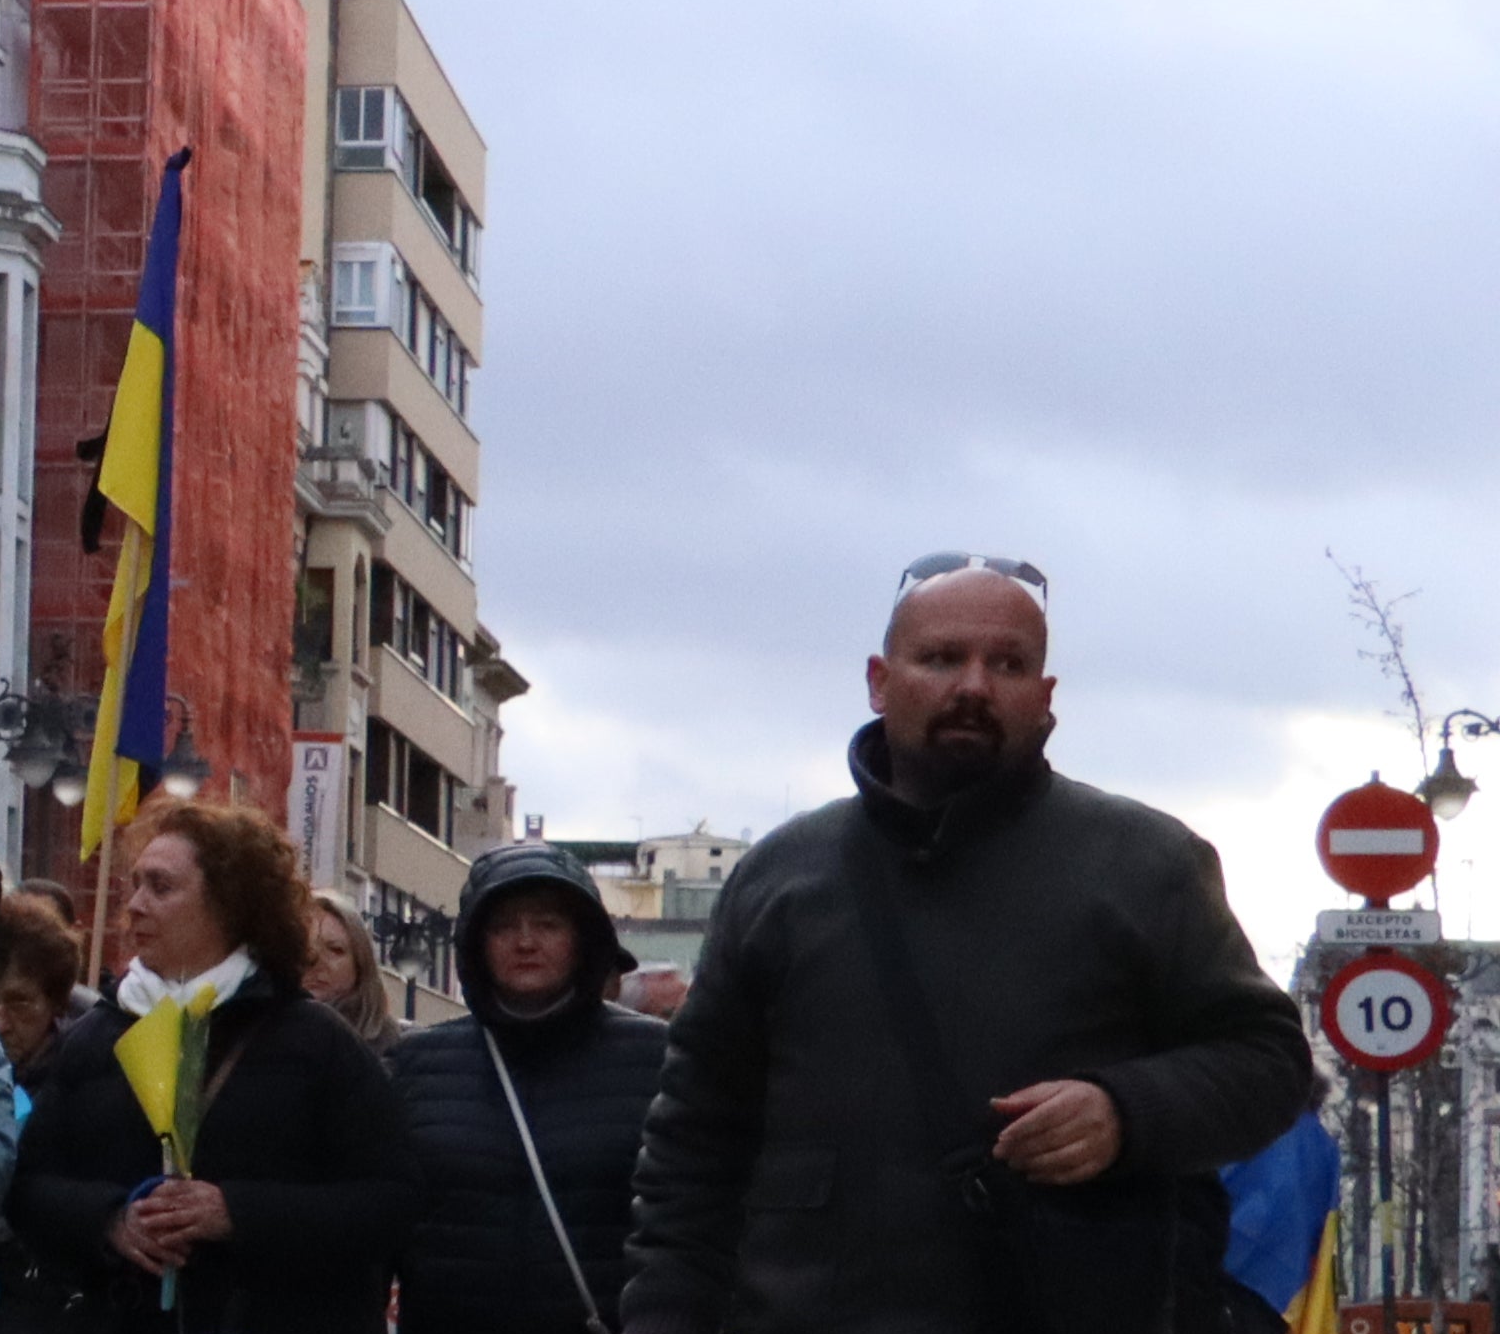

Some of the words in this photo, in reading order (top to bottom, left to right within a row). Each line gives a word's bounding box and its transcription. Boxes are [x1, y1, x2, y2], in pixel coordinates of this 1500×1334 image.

[1345, 915, 1413, 926] EXCEPTO
[1335, 928, 1421, 940] BICICLETAS
[1357, 995, 1413, 1034] 10
